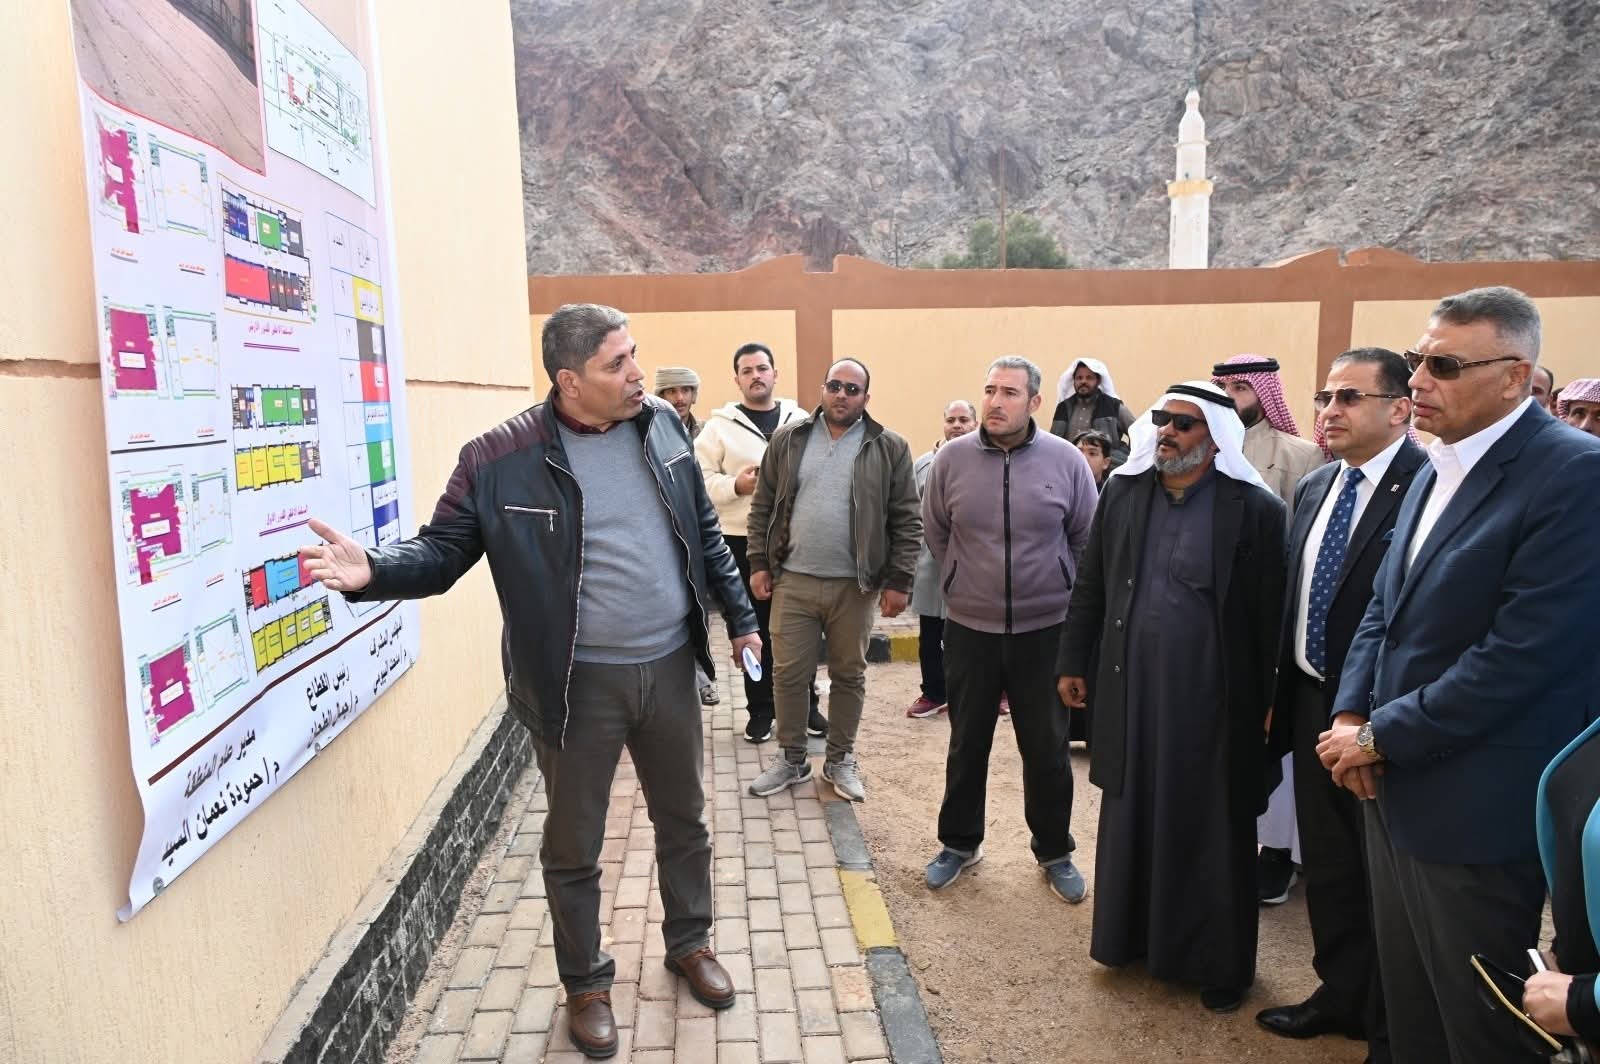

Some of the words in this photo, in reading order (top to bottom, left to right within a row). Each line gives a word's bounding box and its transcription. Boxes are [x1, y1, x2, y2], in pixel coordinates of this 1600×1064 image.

[306, 671, 330, 712] القطاع
[236, 728, 256, 761] مدير
[226, 773, 264, 806] حمودة
[196, 791, 229, 841] نعمان
